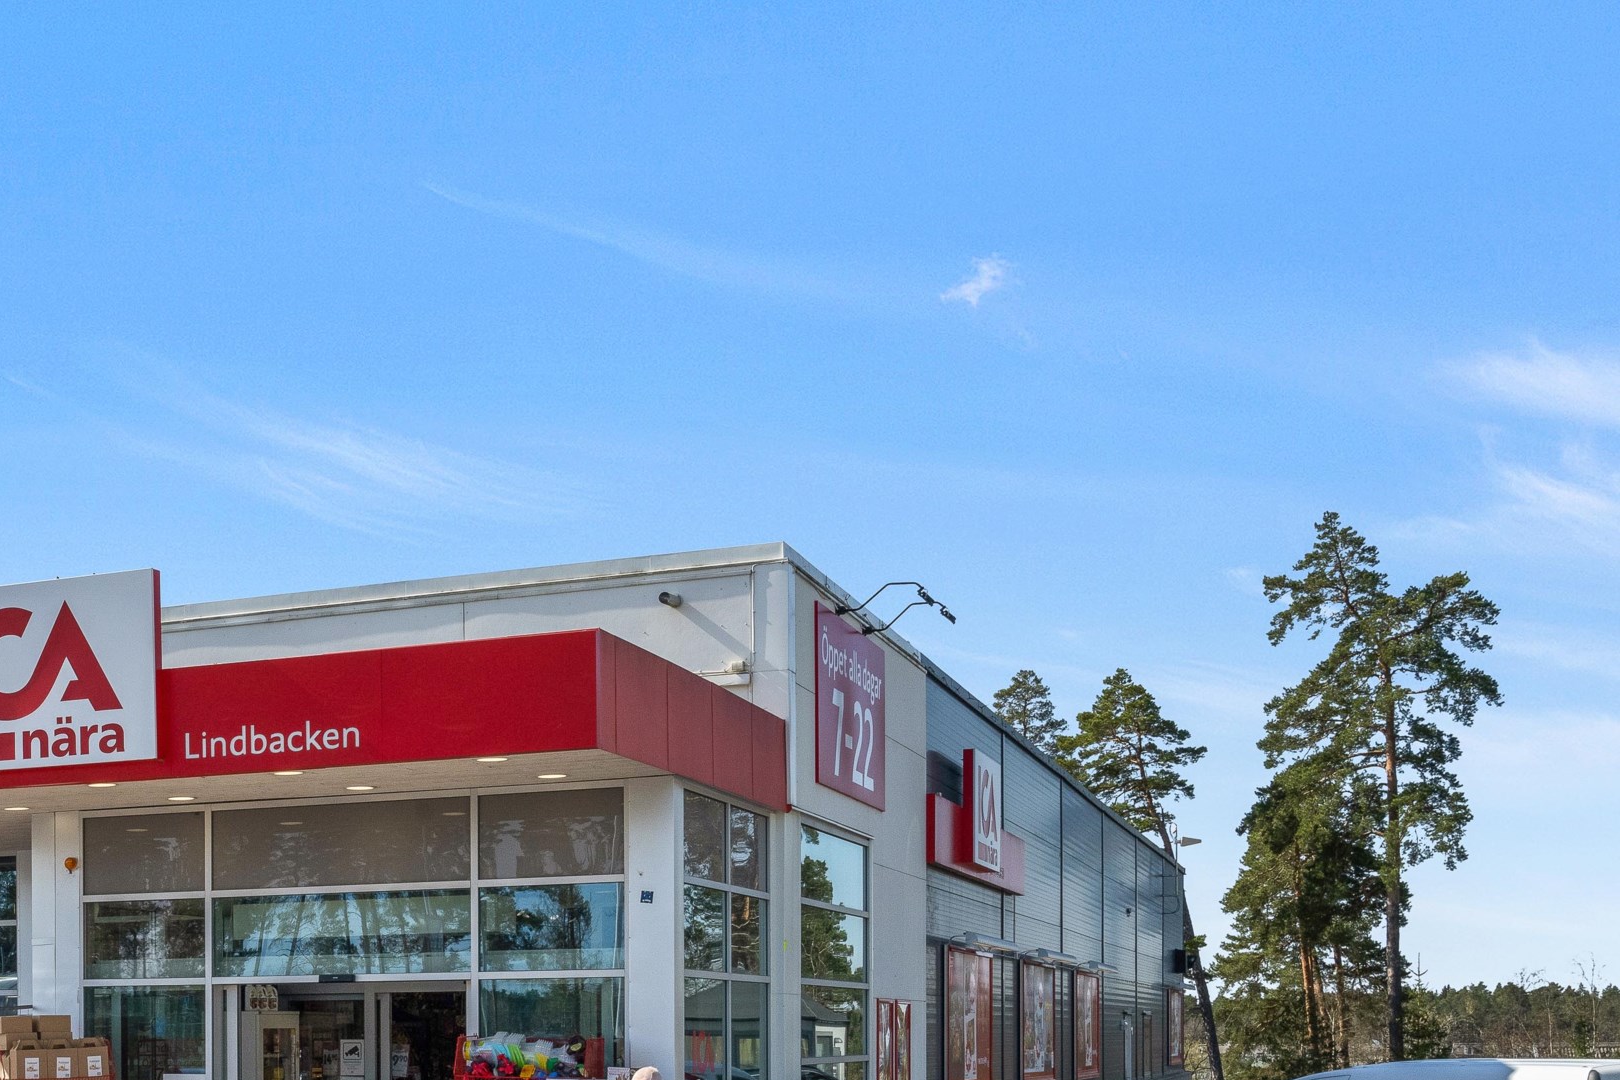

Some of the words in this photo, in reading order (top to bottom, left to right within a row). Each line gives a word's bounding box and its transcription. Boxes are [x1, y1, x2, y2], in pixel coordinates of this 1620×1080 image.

[821, 625, 847, 681] Öppet
[848, 650, 862, 687] alla
[862, 659, 882, 705] dagar
[22, 716, 125, 759] nära
[184, 720, 361, 760] Lindbacken
[832, 688, 875, 792] 7-22
[978, 765, 998, 842] ICA
